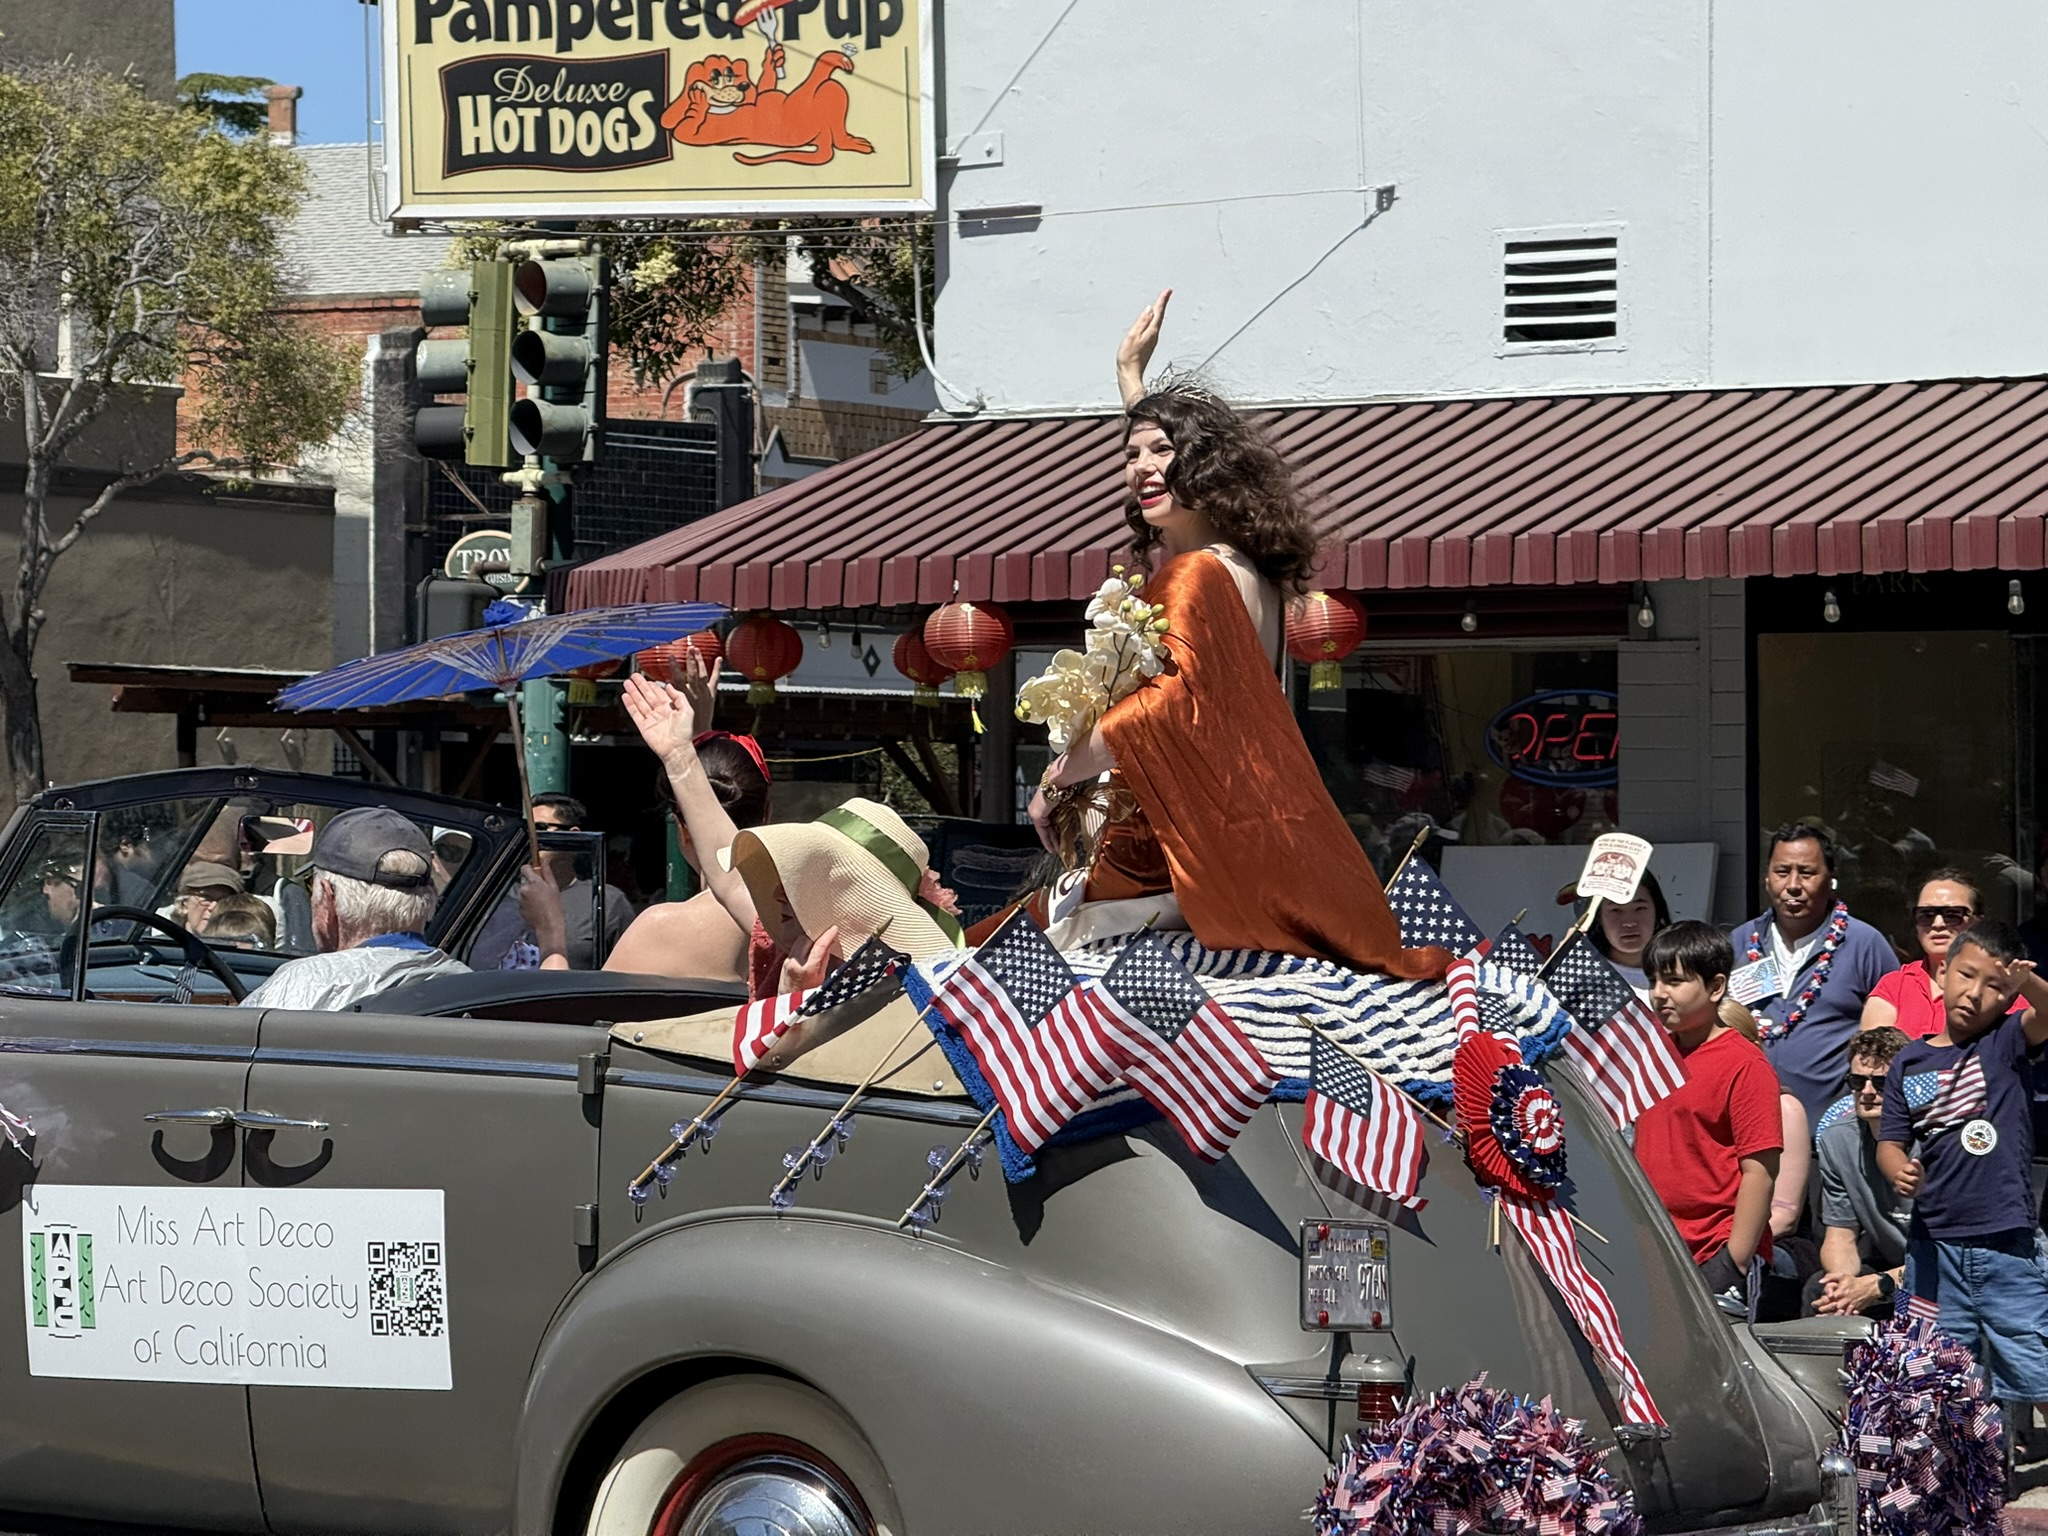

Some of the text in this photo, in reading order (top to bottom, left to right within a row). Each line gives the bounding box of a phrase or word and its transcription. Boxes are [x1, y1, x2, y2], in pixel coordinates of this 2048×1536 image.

[414, 0, 745, 53] Pampered
[493, 65, 632, 105] Deluxe
[457, 90, 657, 157] HOT DOGS
[1851, 572, 1931, 594] PARK
[1510, 713, 1620, 760] OPE
[117, 1205, 335, 1249] Miss Art Deco
[99, 1264, 148, 1304] Art
[160, 1265, 234, 1307] Deco
[248, 1266, 359, 1320] Society
[133, 1324, 328, 1370] of California
